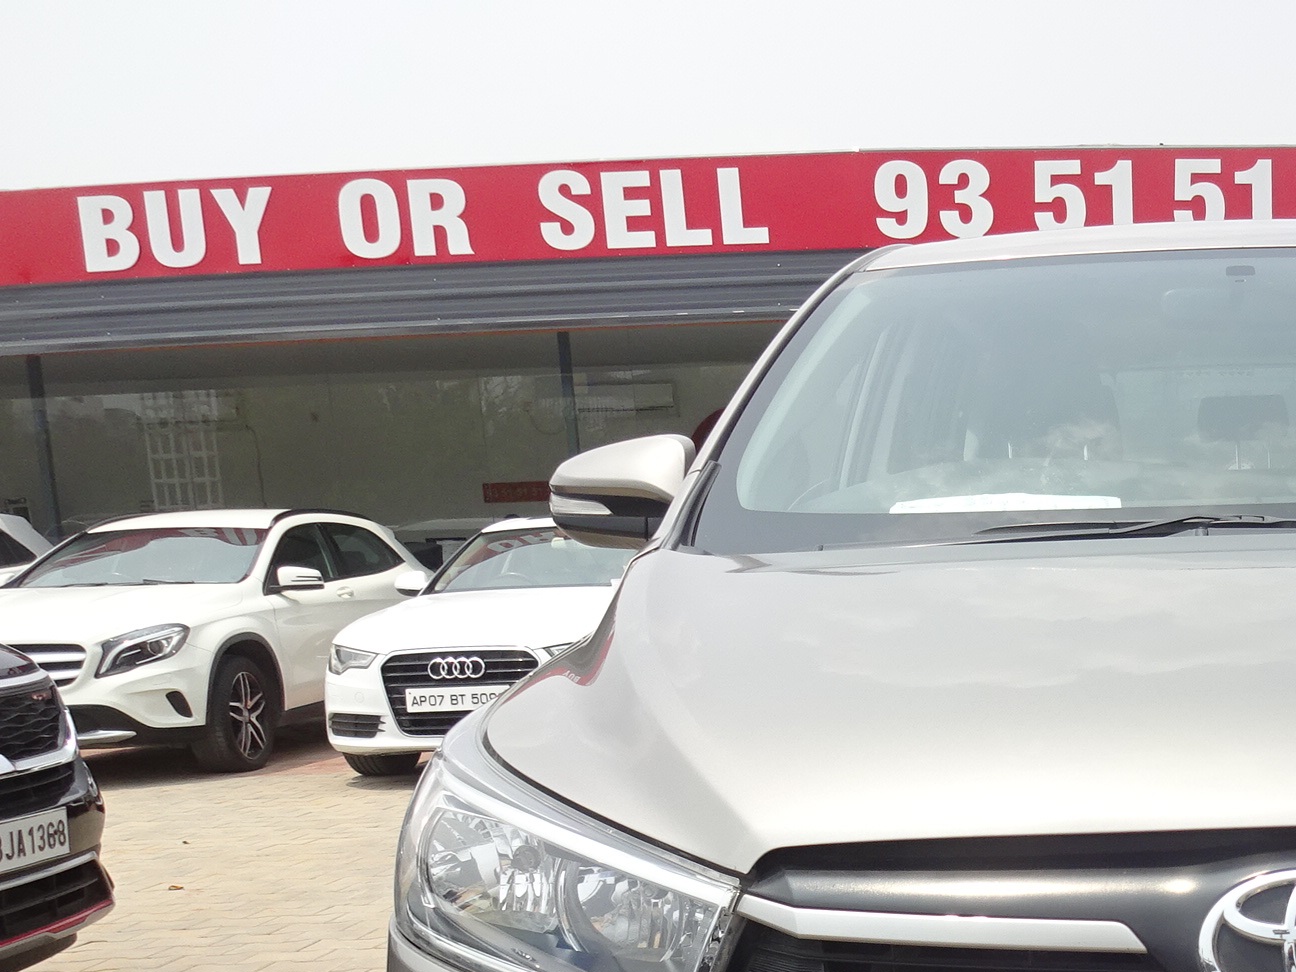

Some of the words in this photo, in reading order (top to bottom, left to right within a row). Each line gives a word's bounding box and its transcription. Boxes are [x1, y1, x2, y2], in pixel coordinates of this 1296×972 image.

[76, 186, 272, 272] BUY
[338, 178, 475, 260] OR
[537, 167, 770, 251] SELL
[874, 159, 994, 239] 93
[1033, 159, 1134, 231] 51
[1173, 158, 1273, 221] 51
[411, 694, 444, 707] AP07
[450, 694, 466, 706] BT
[0, 819, 67, 861] JA1368
